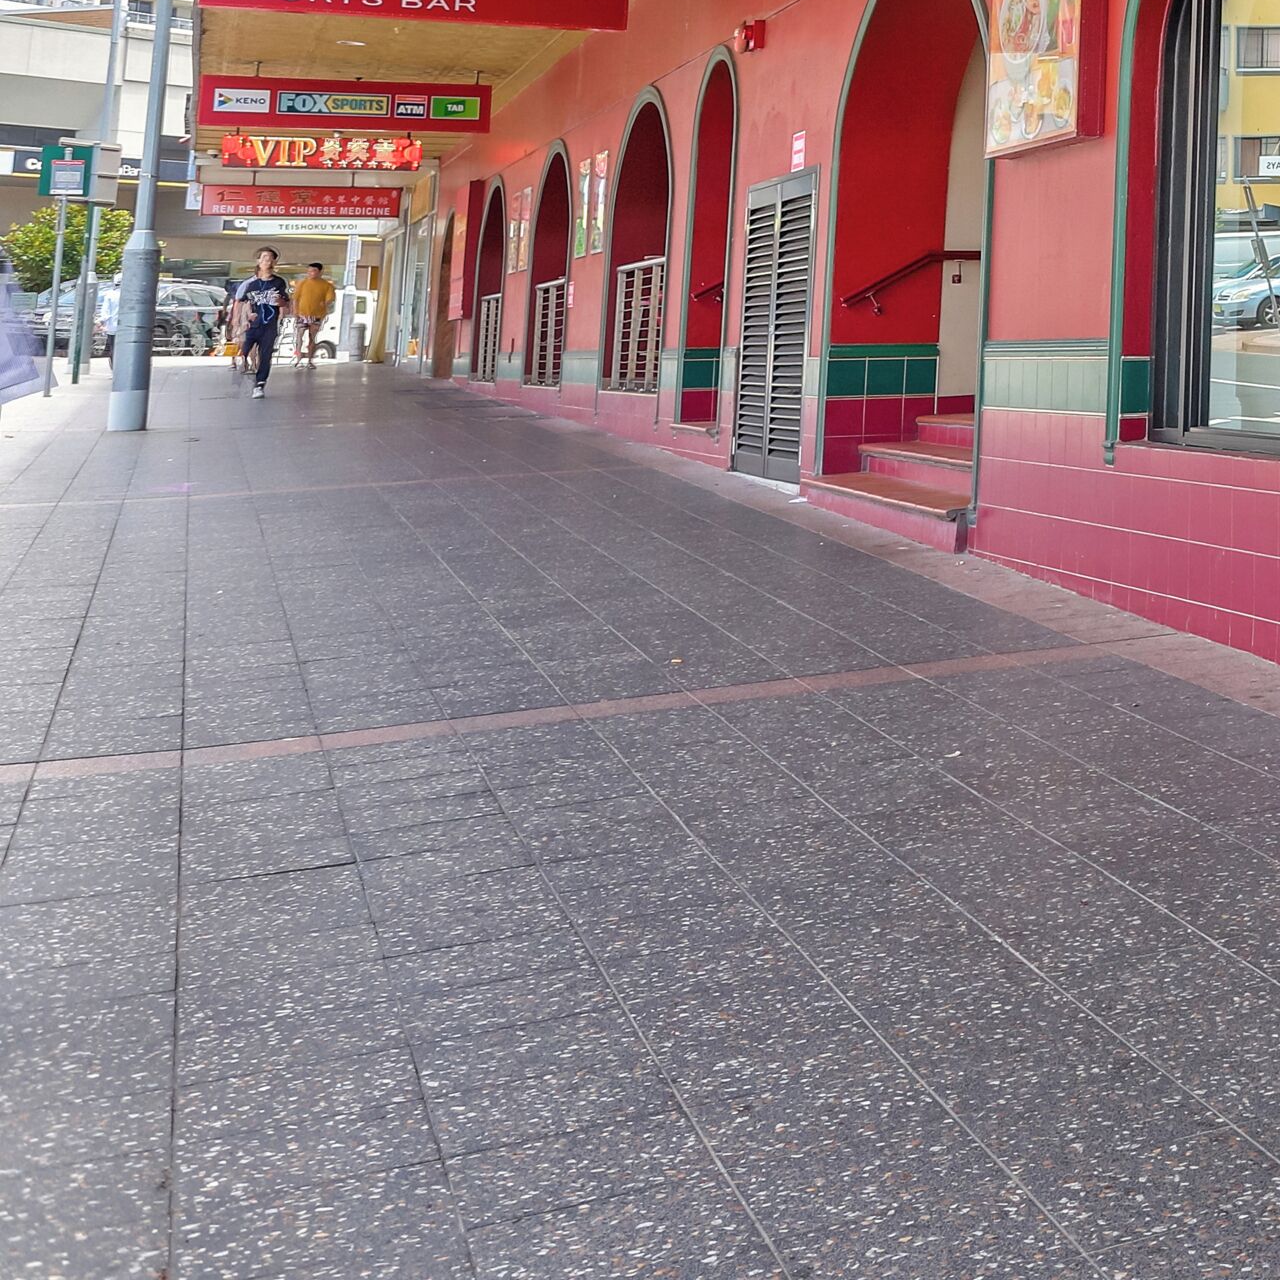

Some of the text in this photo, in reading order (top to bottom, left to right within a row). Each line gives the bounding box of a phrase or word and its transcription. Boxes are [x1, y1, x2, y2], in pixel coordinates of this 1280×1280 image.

[235, 96, 266, 105] KENO
[279, 93, 384, 113] FOX SPORTS
[397, 104, 424, 115] ATM
[446, 103, 464, 112] TAB
[249, 136, 317, 167] VIP
[212, 204, 390, 216] REN DE TANG CHINESE MEDICINE
[279, 223, 358, 231] TEISHOKU YAYOI
